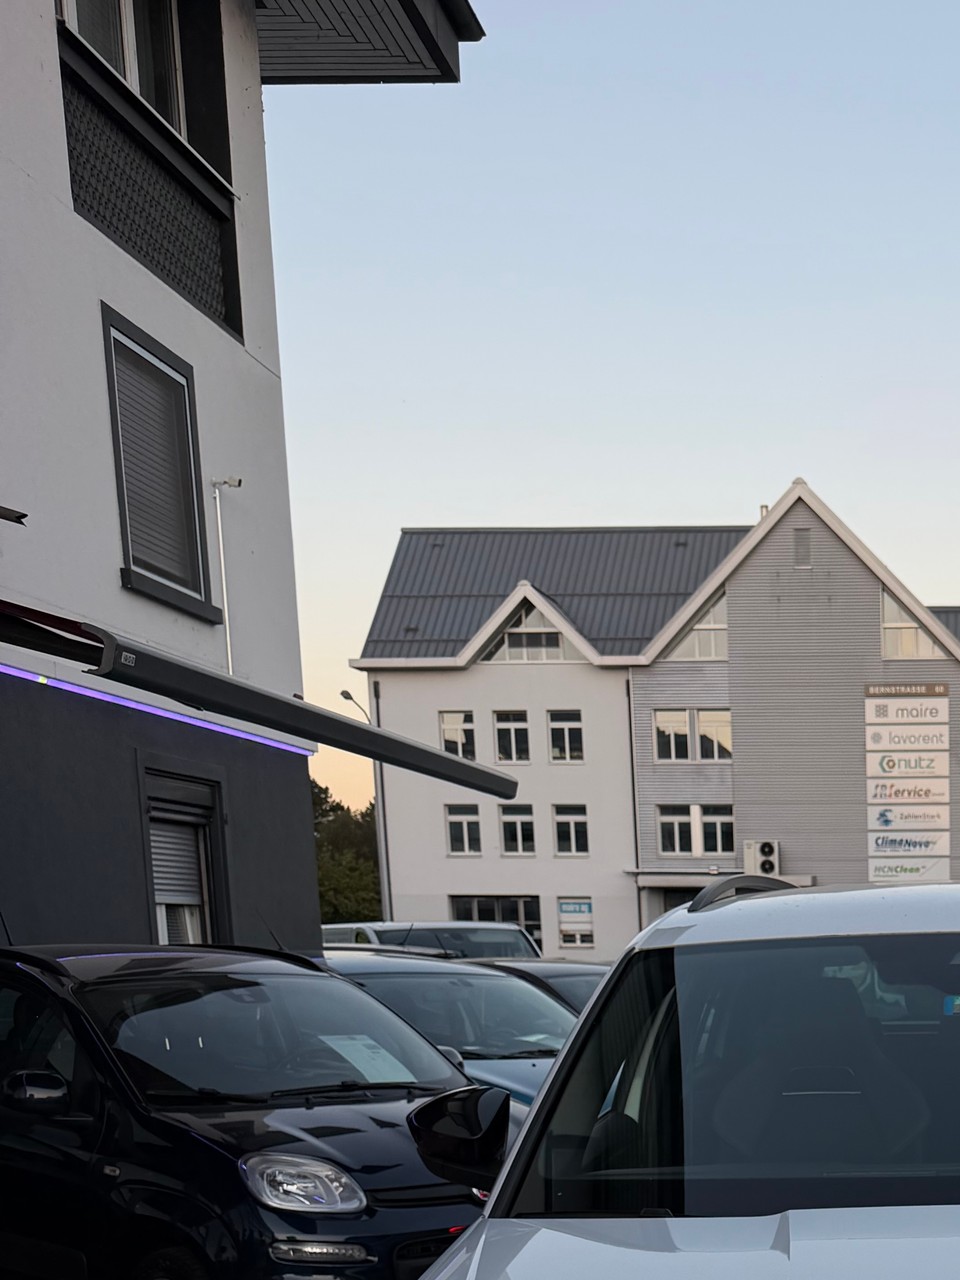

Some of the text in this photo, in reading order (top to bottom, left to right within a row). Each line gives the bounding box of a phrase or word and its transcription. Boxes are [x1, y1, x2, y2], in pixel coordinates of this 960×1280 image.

[868, 685, 926, 694] BERNSTRASSE
[895, 702, 939, 719] maire
[888, 731, 944, 745] lavorent
